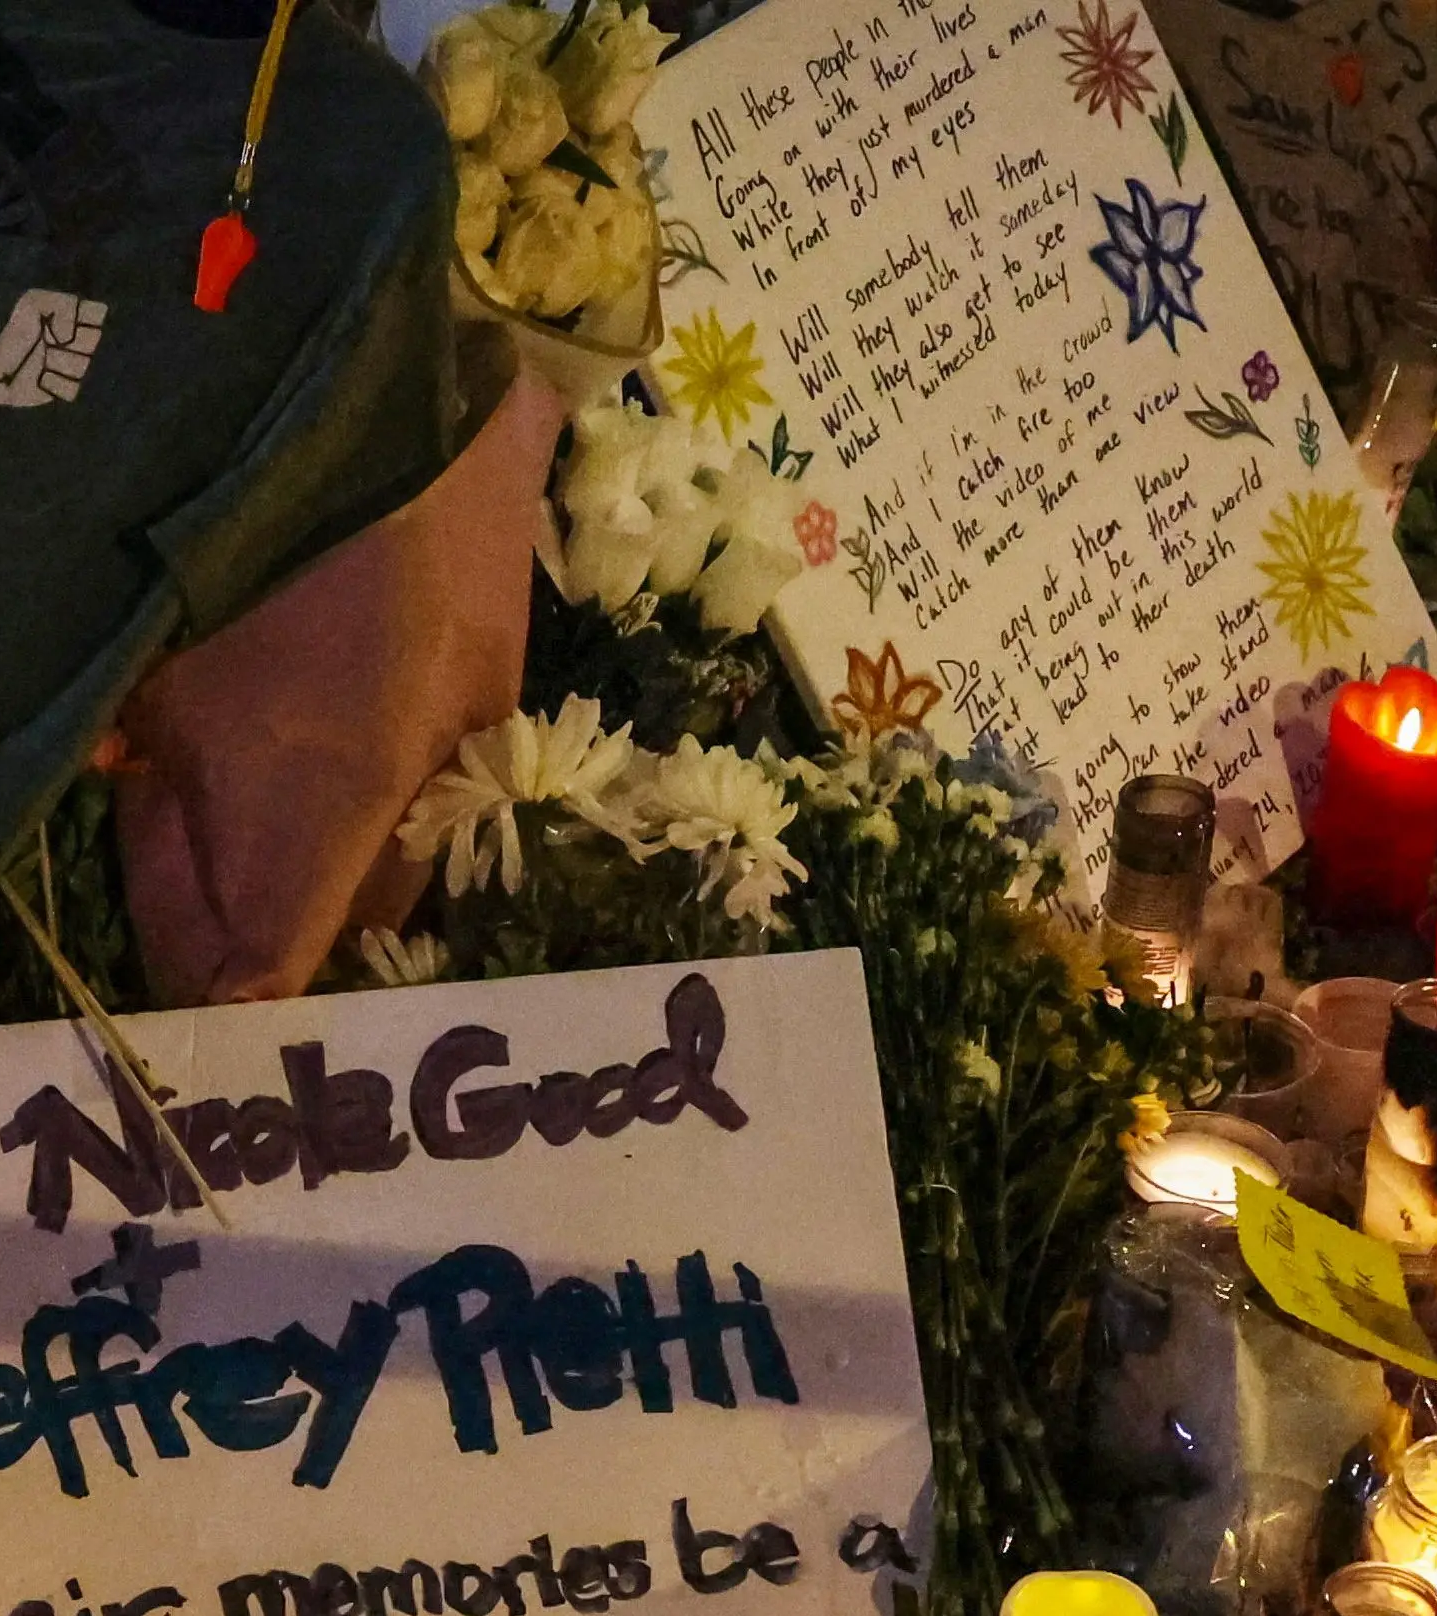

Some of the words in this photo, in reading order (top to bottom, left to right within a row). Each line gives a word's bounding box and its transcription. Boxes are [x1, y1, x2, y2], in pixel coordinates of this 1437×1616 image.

[691, 108, 736, 181] All
[740, 87, 795, 131] these
[806, 28, 860, 98] people
[865, 16, 889, 43] in
[715, 170, 777, 219] Going
[784, 144, 802, 166] on
[815, 88, 859, 138] with
[870, 49, 917, 92] their
[930, 3, 977, 43] lives
[732, 200, 793, 252] While
[802, 158, 850, 198] they
[904, 48, 976, 126] murdered
[988, 44, 1000, 60] a
[1009, 9, 1048, 46] man
[785, 211, 830, 261] front
[850, 175, 869, 217] of
[891, 146, 925, 180] my
[931, 100, 976, 155] eyes
[780, 303, 829, 365] Will
[845, 234, 939, 313] somebody
[945, 186, 981, 231] tell
[996, 149, 1050, 191] them
[799, 352, 842, 400] Will
[853, 316, 901, 359] they
[905, 259, 960, 318] watch
[970, 232, 985, 262] it
[1000, 170, 1079, 238] someday
[821, 385, 864, 440] Will
[871, 359, 915, 398] they
[920, 323, 954, 360] also
[965, 274, 992, 335] get
[1003, 254, 1023, 281] to
[1036, 222, 1067, 259] see
[837, 416, 882, 469] What
[891, 397, 905, 424] I
[920, 314, 998, 400] witnessed
[1016, 262, 1071, 315] today
[863, 478, 907, 536] And
[920, 450, 935, 487] if
[991, 403, 1008, 424] in
[1017, 365, 1048, 396] the
[1063, 295, 1115, 364] crowd
[884, 523, 923, 577] And
[928, 497, 943, 523] I
[1018, 408, 1054, 442] fire
[1064, 372, 1096, 404] too
[897, 550, 941, 604] Will
[953, 516, 985, 552] the
[996, 461, 1045, 509] video
[1058, 418, 1077, 454] of
[1087, 393, 1113, 428] me
[984, 522, 1025, 566] more
[1039, 470, 1080, 516] than
[1095, 431, 1122, 463] one
[1133, 381, 1182, 425] view
[1035, 640, 1091, 691] being
[1097, 589, 1124, 629] out
[1131, 570, 1155, 596] in
[1160, 529, 1199, 566] this
[1212, 456, 1265, 524] world
[936, 659, 981, 693] Do
[1001, 605, 1038, 651] any
[1044, 565, 1061, 602] of
[1072, 518, 1123, 565] them
[963, 670, 1007, 733] That
[1017, 639, 1033, 674] it
[1049, 575, 1095, 636] could
[1106, 550, 1136, 580] be
[1147, 490, 1199, 541] them
[1051, 671, 1089, 727] lead
[1096, 642, 1120, 672] to
[1130, 591, 1171, 634] their
[1185, 530, 1238, 588] death
[1076, 733, 1131, 802] going
[1127, 695, 1152, 725] to
[1163, 653, 1202, 696] show
[1216, 598, 1262, 640] them
[1273, 719, 1286, 740] a
[1301, 669, 1348, 711] man
[1072, 789, 1117, 835] they
[1132, 744, 1161, 779] can
[1168, 685, 1210, 726] take
[1220, 611, 1271, 681] stand
[1174, 738, 1209, 777] the
[1219, 675, 1272, 727] video
[411, 973, 749, 1163] Good
[387, 1243, 800, 1453] Pretti
[669, 1497, 800, 1597] be
[837, 1512, 920, 1576] a
